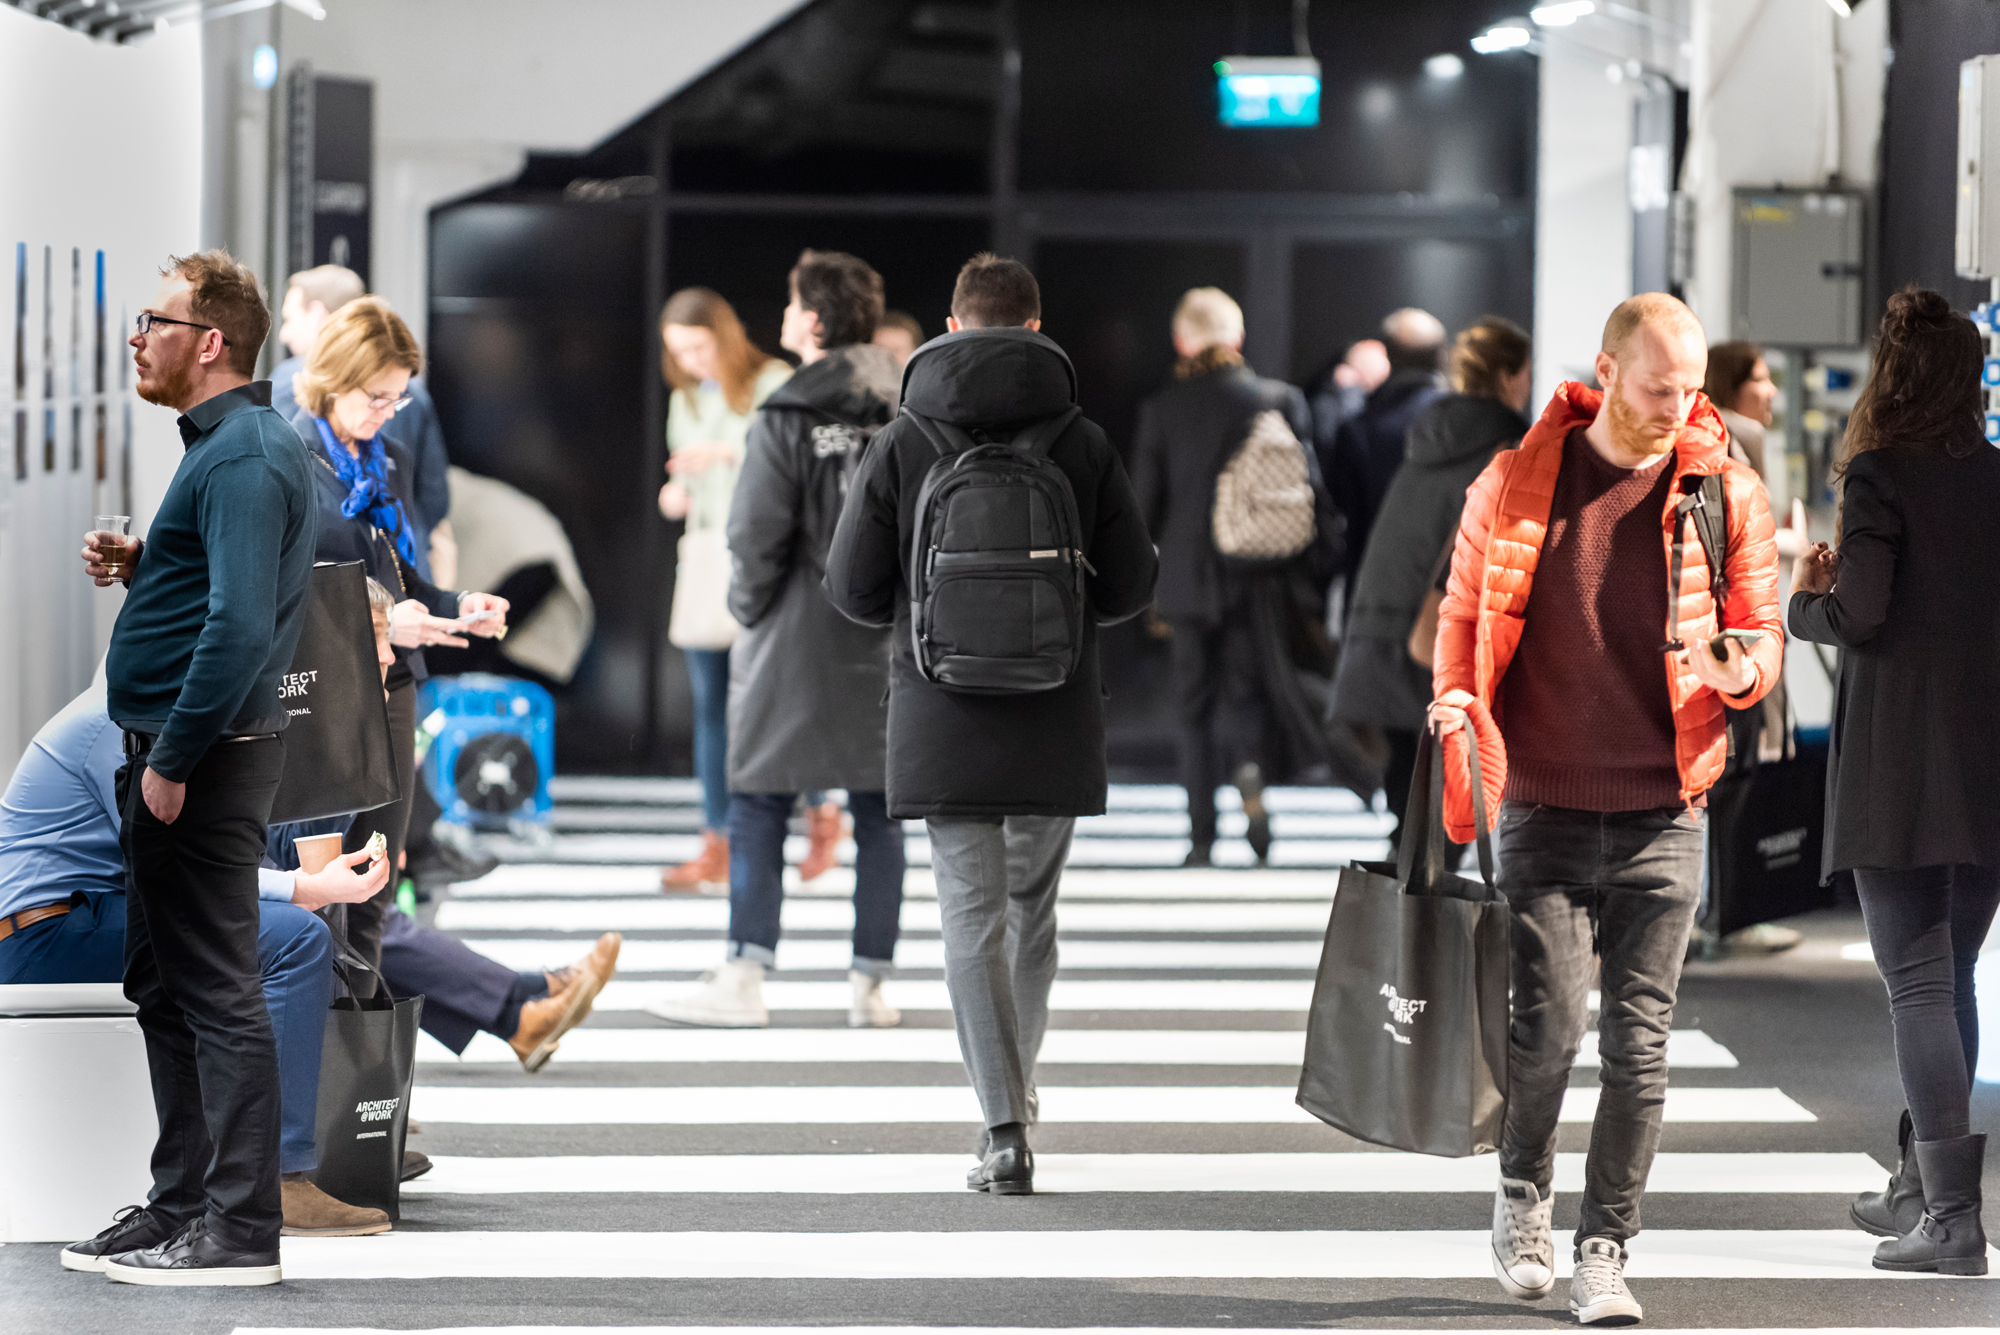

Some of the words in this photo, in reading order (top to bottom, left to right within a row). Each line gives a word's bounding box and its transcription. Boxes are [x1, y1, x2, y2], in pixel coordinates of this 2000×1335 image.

[277, 683, 308, 699] ORK
[286, 707, 312, 717] IONAL
[355, 1097, 400, 1113] ARCHITECT
[360, 1109, 393, 1122] @WORK
